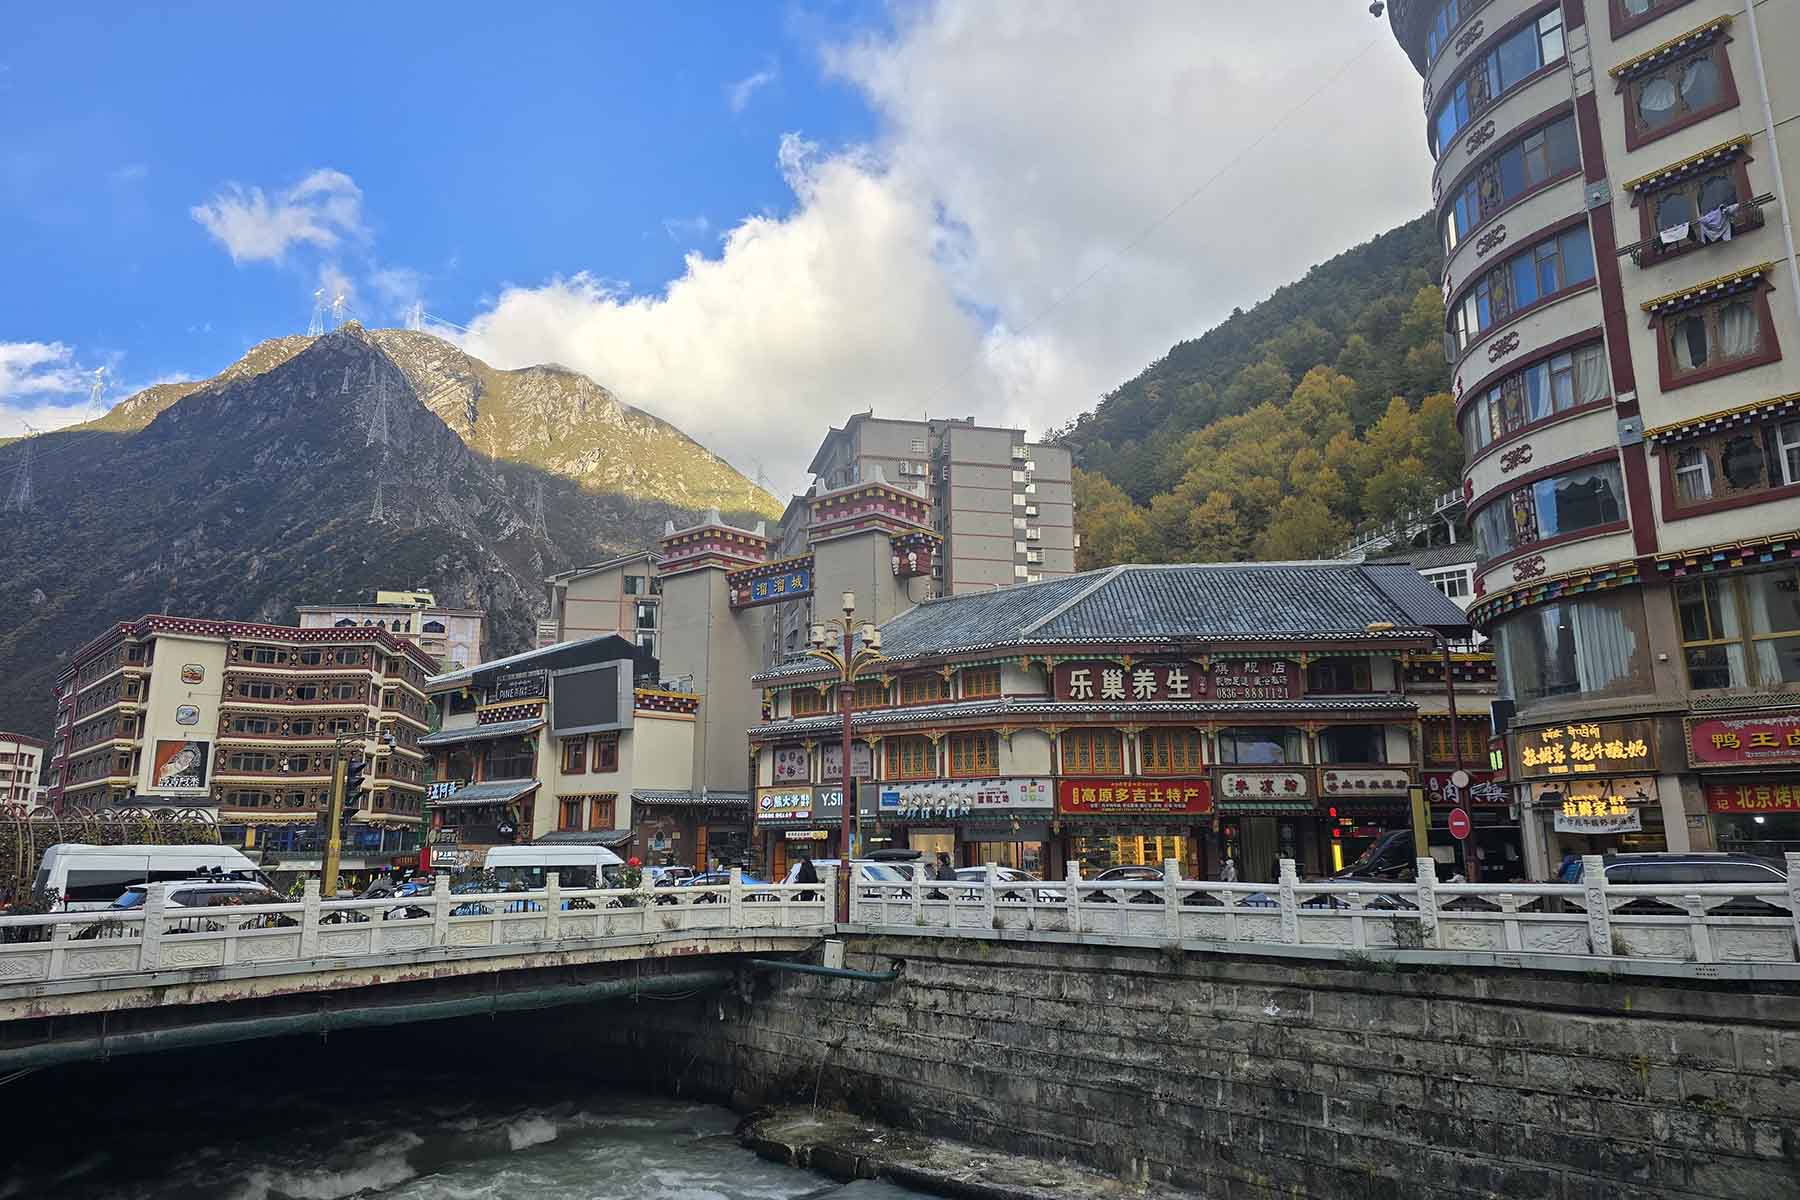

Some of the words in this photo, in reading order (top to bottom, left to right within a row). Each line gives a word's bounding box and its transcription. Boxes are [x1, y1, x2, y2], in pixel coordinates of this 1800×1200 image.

[756, 575, 803, 596] 溜溜城
[1215, 661, 1286, 674] 旗舰店
[1070, 668, 1192, 700] 乐巢养生
[1216, 687, 1289, 699] 0836-8881121
[1569, 739, 1648, 761] 牦牛酸奶
[1081, 787, 1199, 803] 高原多吉土特产
